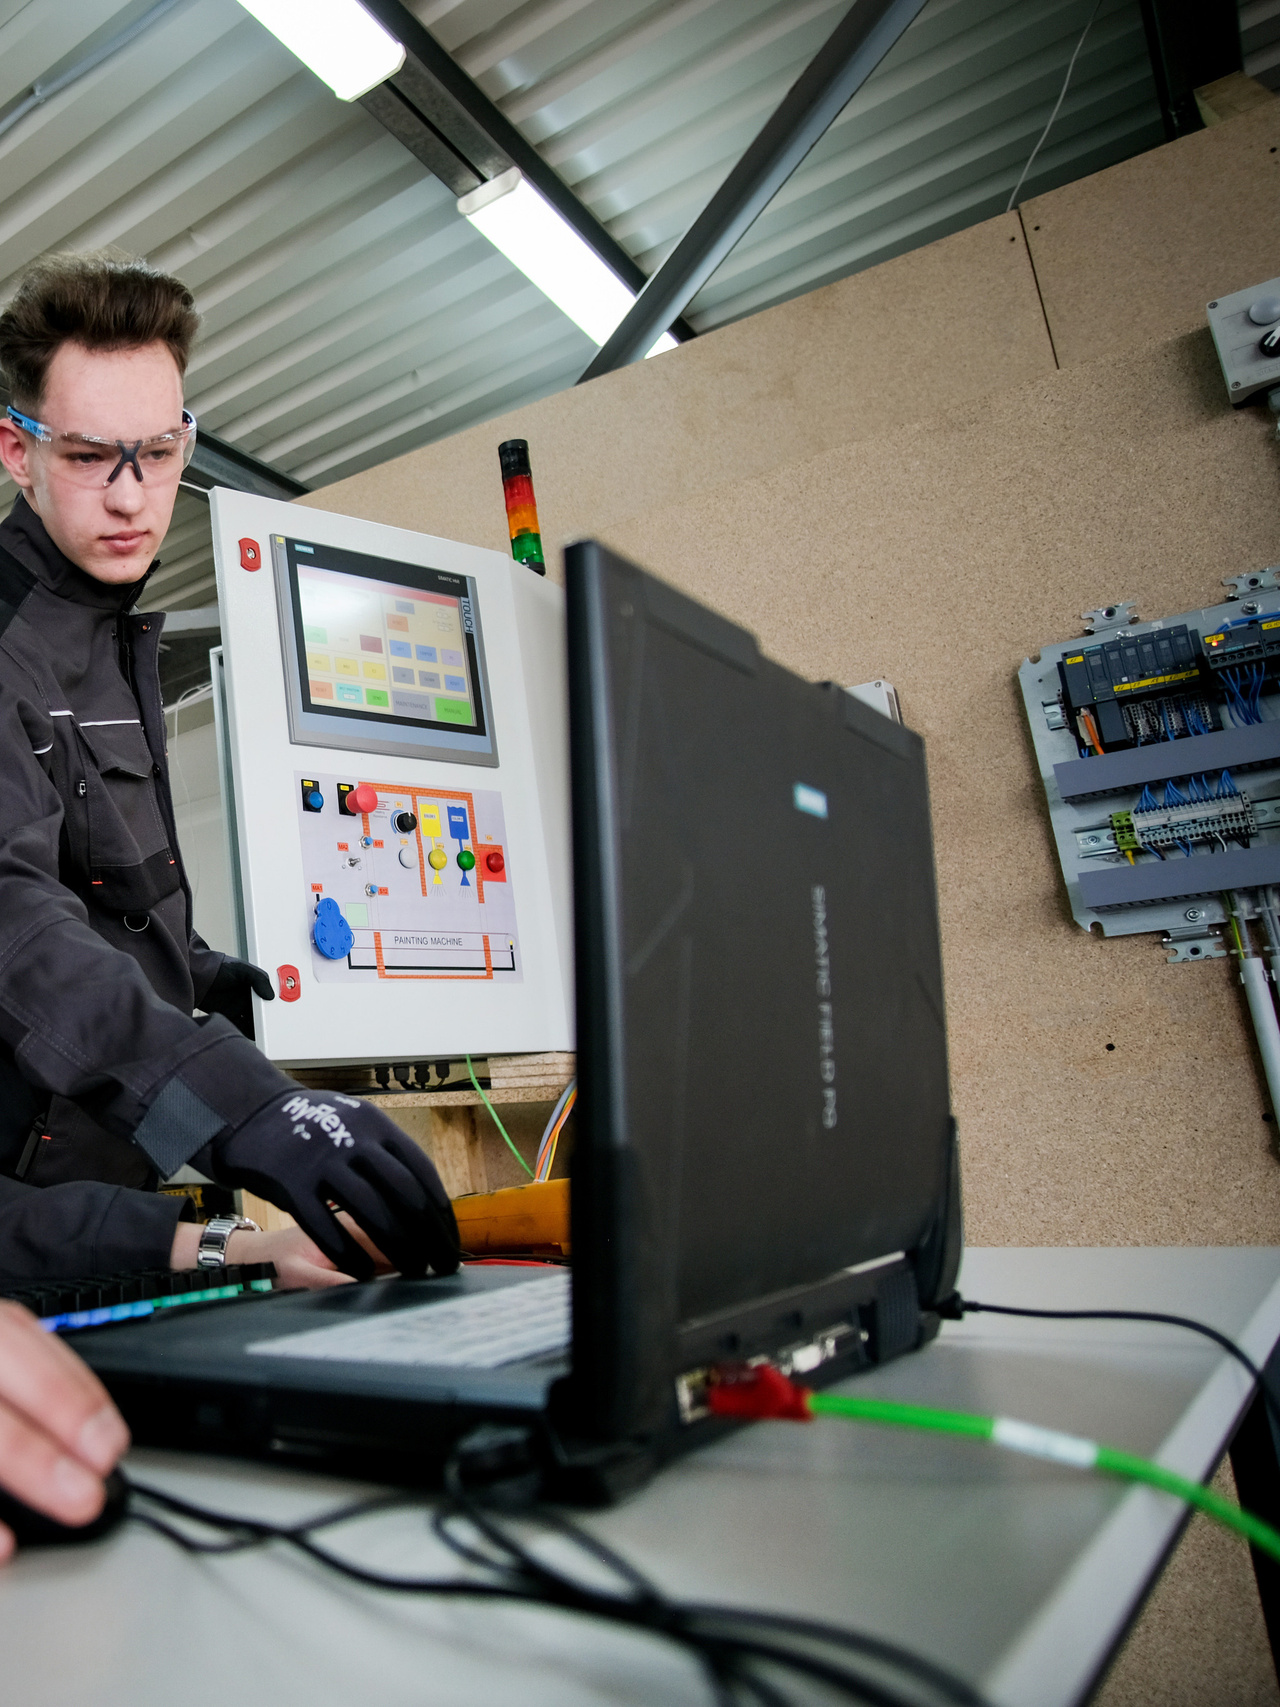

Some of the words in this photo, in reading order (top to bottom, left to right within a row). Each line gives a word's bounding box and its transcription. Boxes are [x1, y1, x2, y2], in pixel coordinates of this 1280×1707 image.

[462, 599, 474, 633] TOUCH
[394, 935, 429, 946] PAINTING
[430, 937, 463, 947] MACHINE
